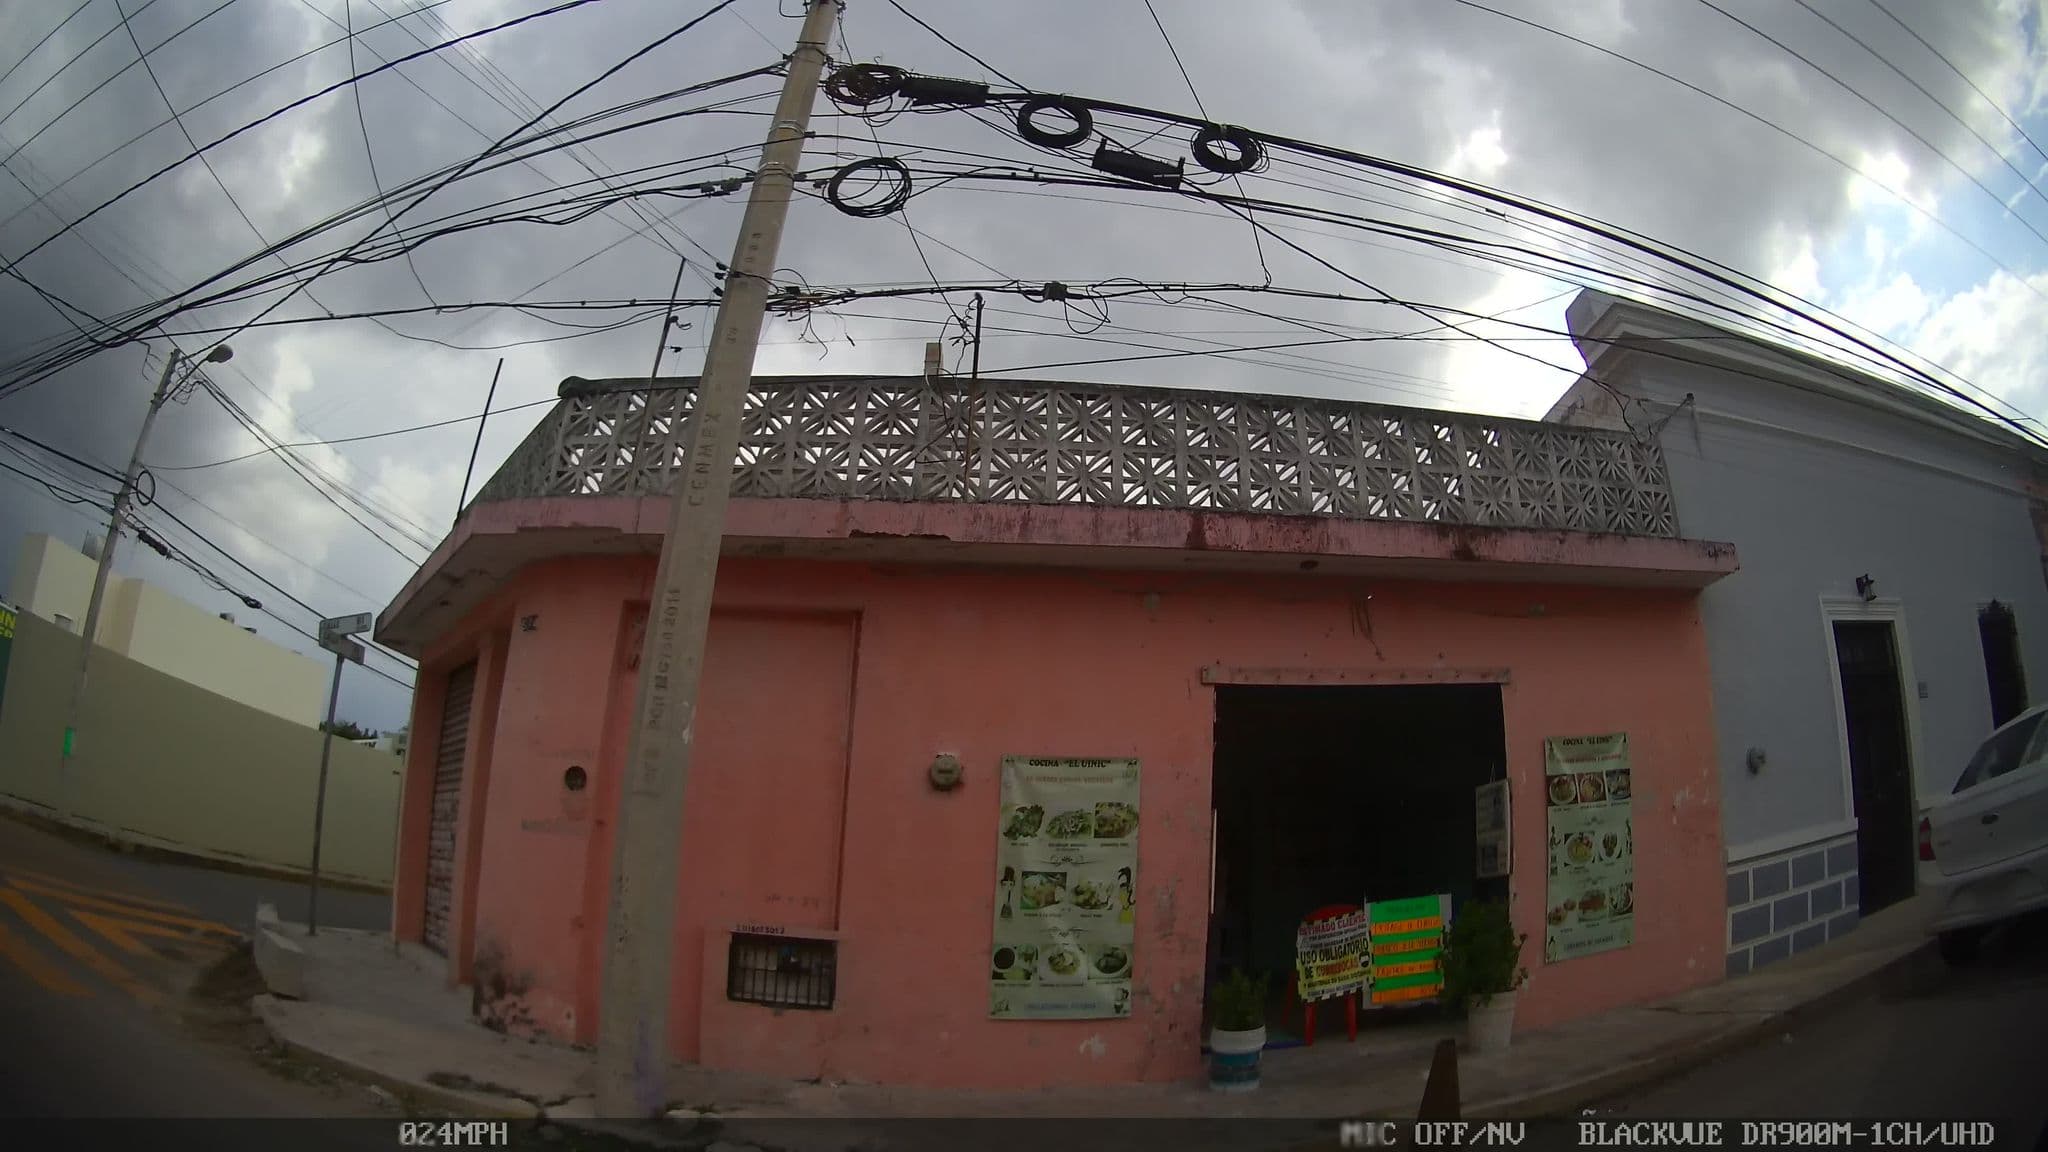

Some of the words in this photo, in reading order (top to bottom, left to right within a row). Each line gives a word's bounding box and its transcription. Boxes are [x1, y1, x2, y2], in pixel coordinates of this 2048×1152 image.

[1029, 759, 1059, 767] COCINA
[1300, 950, 1317, 965] USO
[1319, 938, 1368, 961] OBLIGATORIO
[1305, 966, 1313, 979] DE
